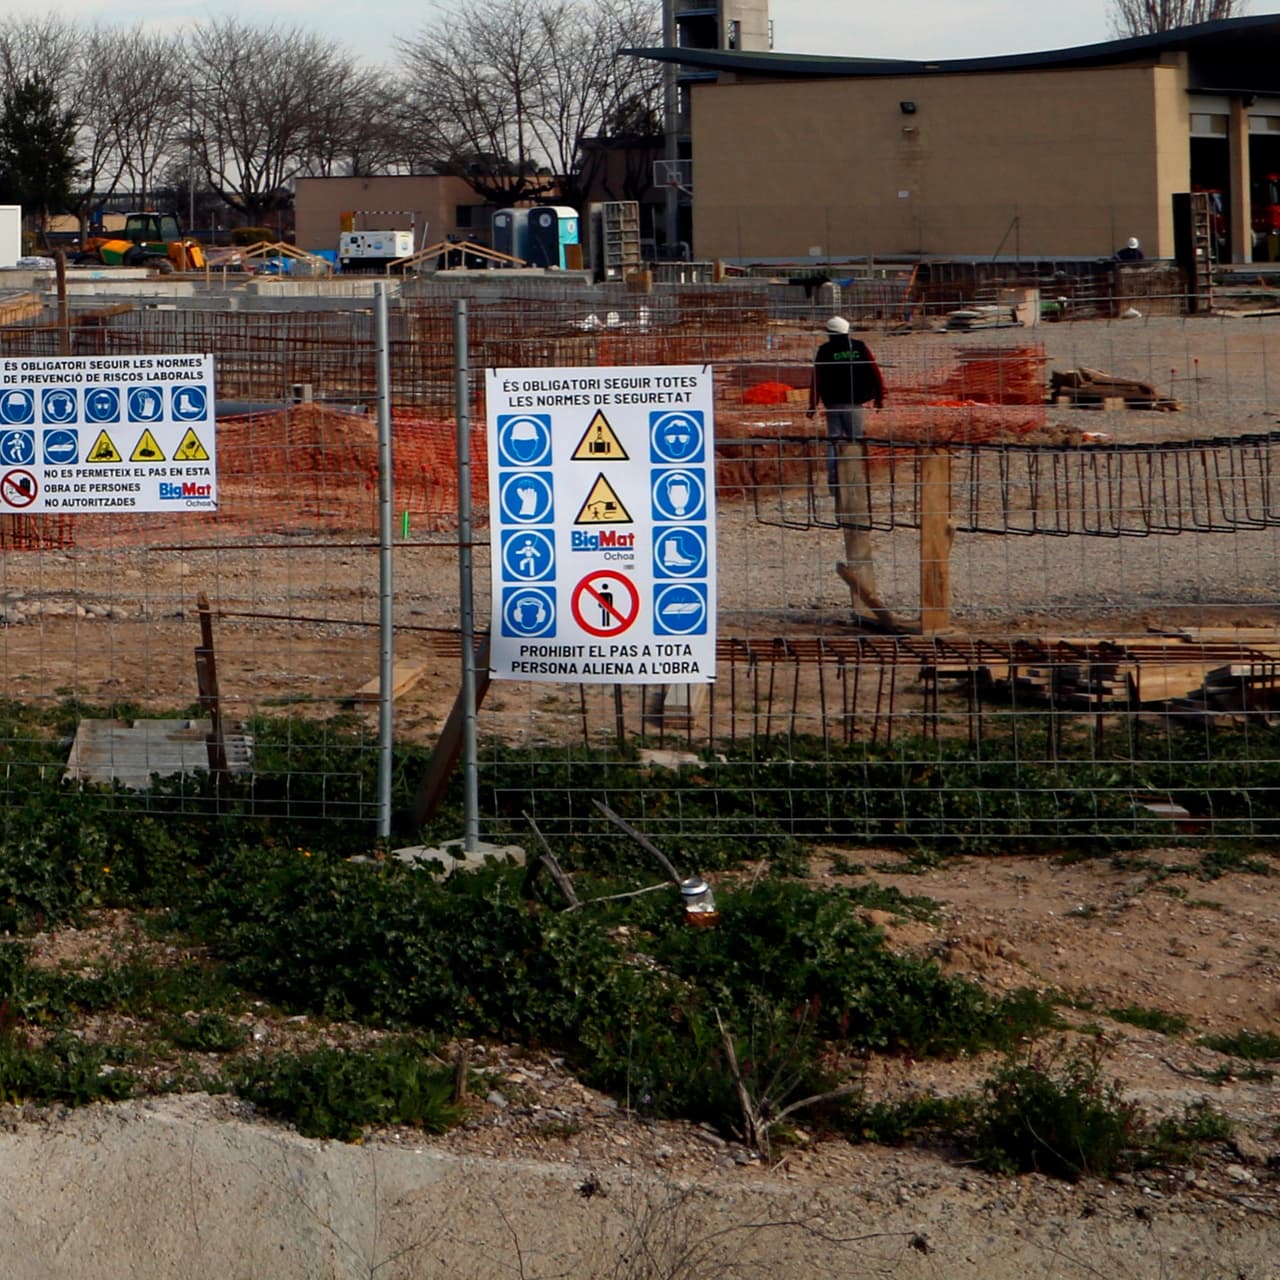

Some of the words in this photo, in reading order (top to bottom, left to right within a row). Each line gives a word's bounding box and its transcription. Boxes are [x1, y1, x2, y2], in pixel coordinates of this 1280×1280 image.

[4, 360, 18, 371] ÉS
[21, 361, 87, 370] OBLIGATORI
[90, 360, 130, 370] SEGUIR
[134, 359, 153, 369] LES
[157, 358, 202, 368] NORMES
[3, 374, 18, 384] DE
[21, 372, 83, 383] PREVENCIÓ
[86, 373, 101, 382] DE
[104, 372, 143, 382] RISCOS
[147, 371, 203, 381] LABORALS
[502, 378, 519, 392] ÉS
[522, 379, 600, 391] OBLIGATORI
[604, 377, 651, 389] SEGUIR
[655, 376, 697, 388] TOTES
[509, 396, 533, 407] LES
[537, 394, 591, 406] NORMES
[594, 393, 611, 405] DE
[614, 392, 692, 404] SEGURETAT
[44, 469, 58, 478] NO
[61, 469, 73, 478] ES
[76, 468, 131, 477] PERMETEIX
[134, 468, 146, 477] EL
[149, 468, 167, 477] PAS
[170, 467, 183, 476] EN
[186, 467, 211, 476] ESTA
[44, 484, 71, 493] OBRA
[74, 484, 86, 493] DE
[89, 483, 141, 492] PERSONES
[159, 482, 212, 499] BigMat
[45, 499, 60, 508] NO
[62, 497, 136, 507] AUTORITZADES
[571, 530, 635, 551] BigMat
[604, 552, 634, 561] Ochoa
[520, 645, 585, 658] PROHIBIT
[589, 645, 606, 657] EL
[610, 645, 638, 657] PAS
[642, 645, 652, 656] A
[655, 644, 692, 656] TOTA
[512, 661, 578, 674] PERSONA
[582, 662, 635, 674] ALIENA
[639, 662, 648, 673] A
